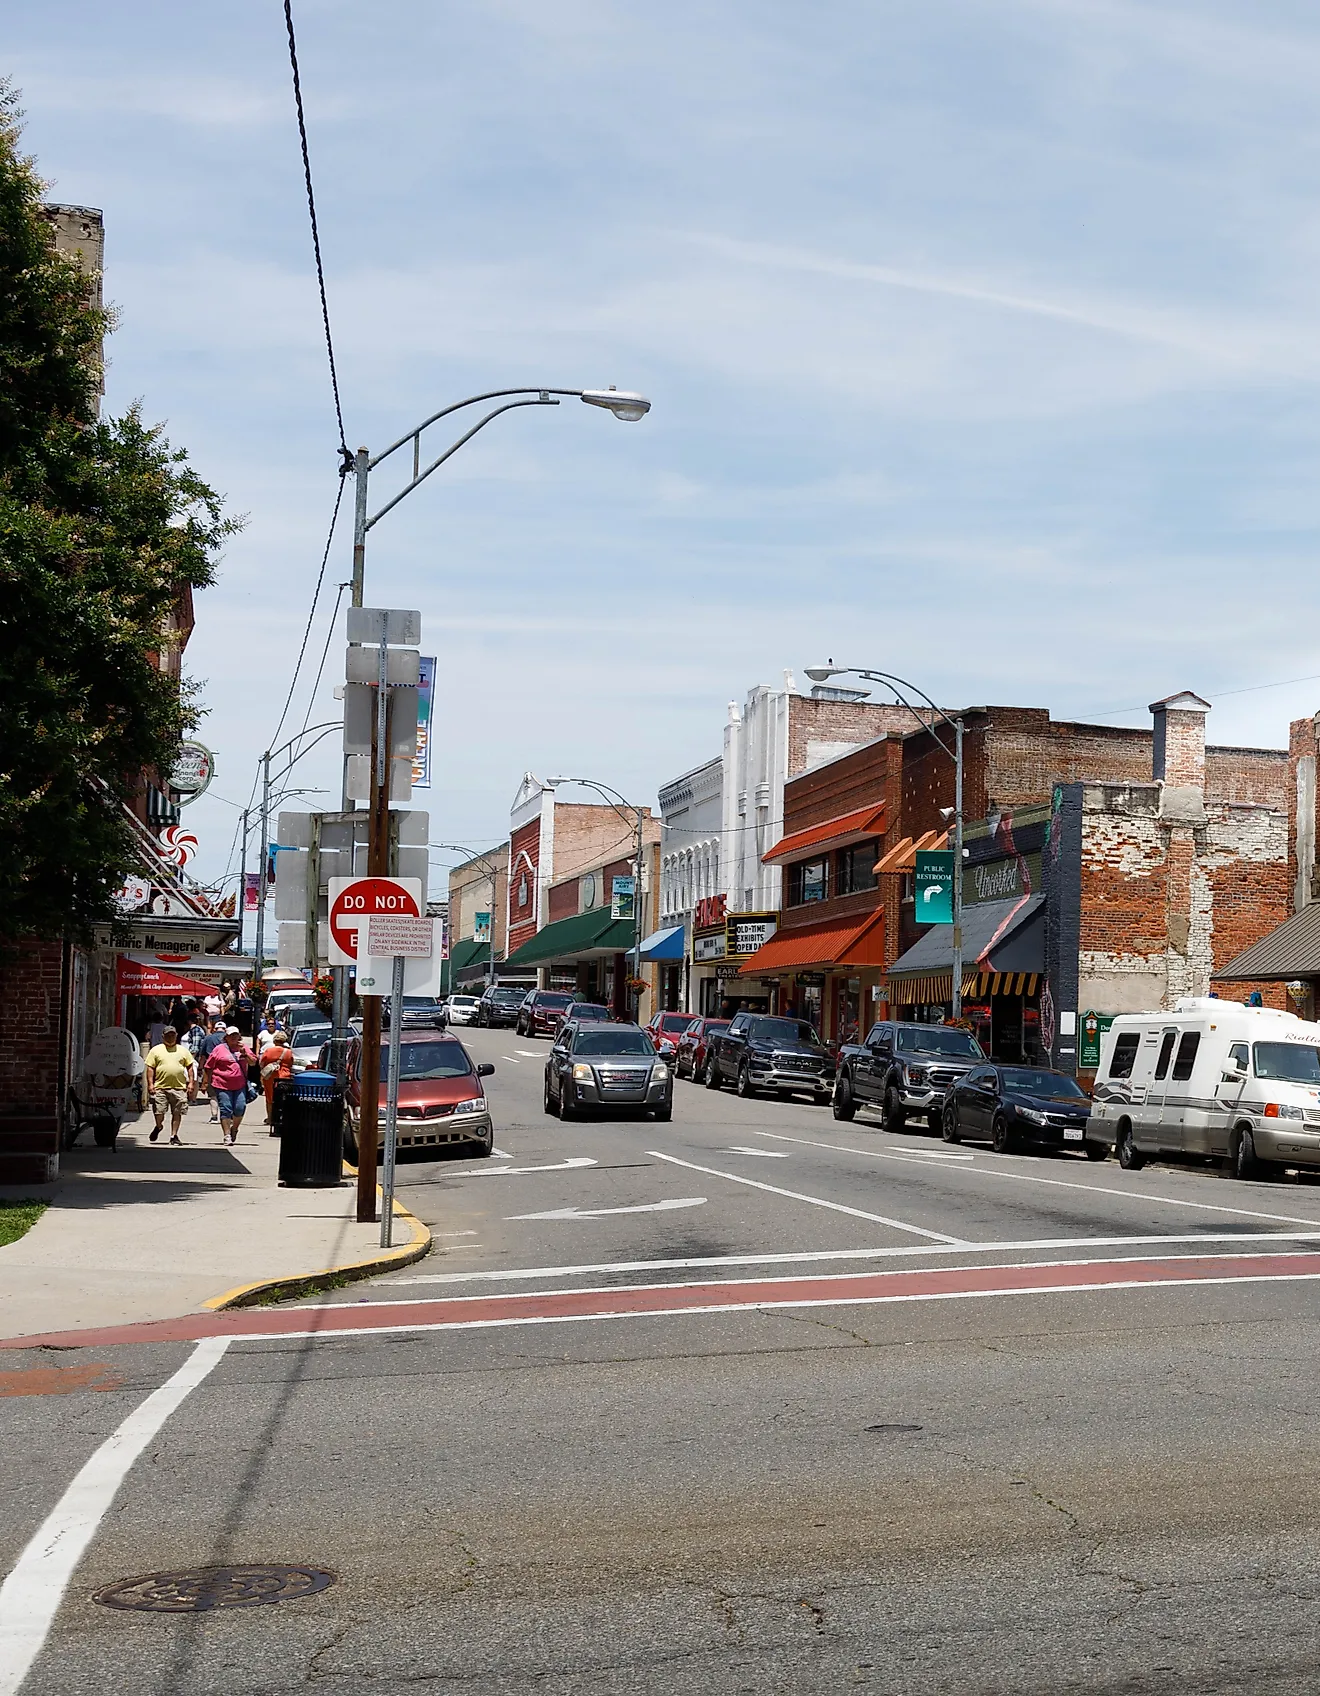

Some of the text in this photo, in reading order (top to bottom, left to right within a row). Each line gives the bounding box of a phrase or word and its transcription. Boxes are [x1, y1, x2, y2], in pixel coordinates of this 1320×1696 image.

[923, 865, 945, 873] PUBLIC
[916, 873, 952, 881] RESTROOM
[344, 895, 407, 909] DO NOT
[736, 924, 766, 933] OLD-TIME
[737, 933, 764, 943] EXHIBITS
[144, 934, 200, 954] Menagerie
[736, 943, 753, 952] OPEN
[143, 971, 160, 980] Lunch
[717, 967, 738, 975] EARL
[1285, 1031, 1320, 1044] Rialta
